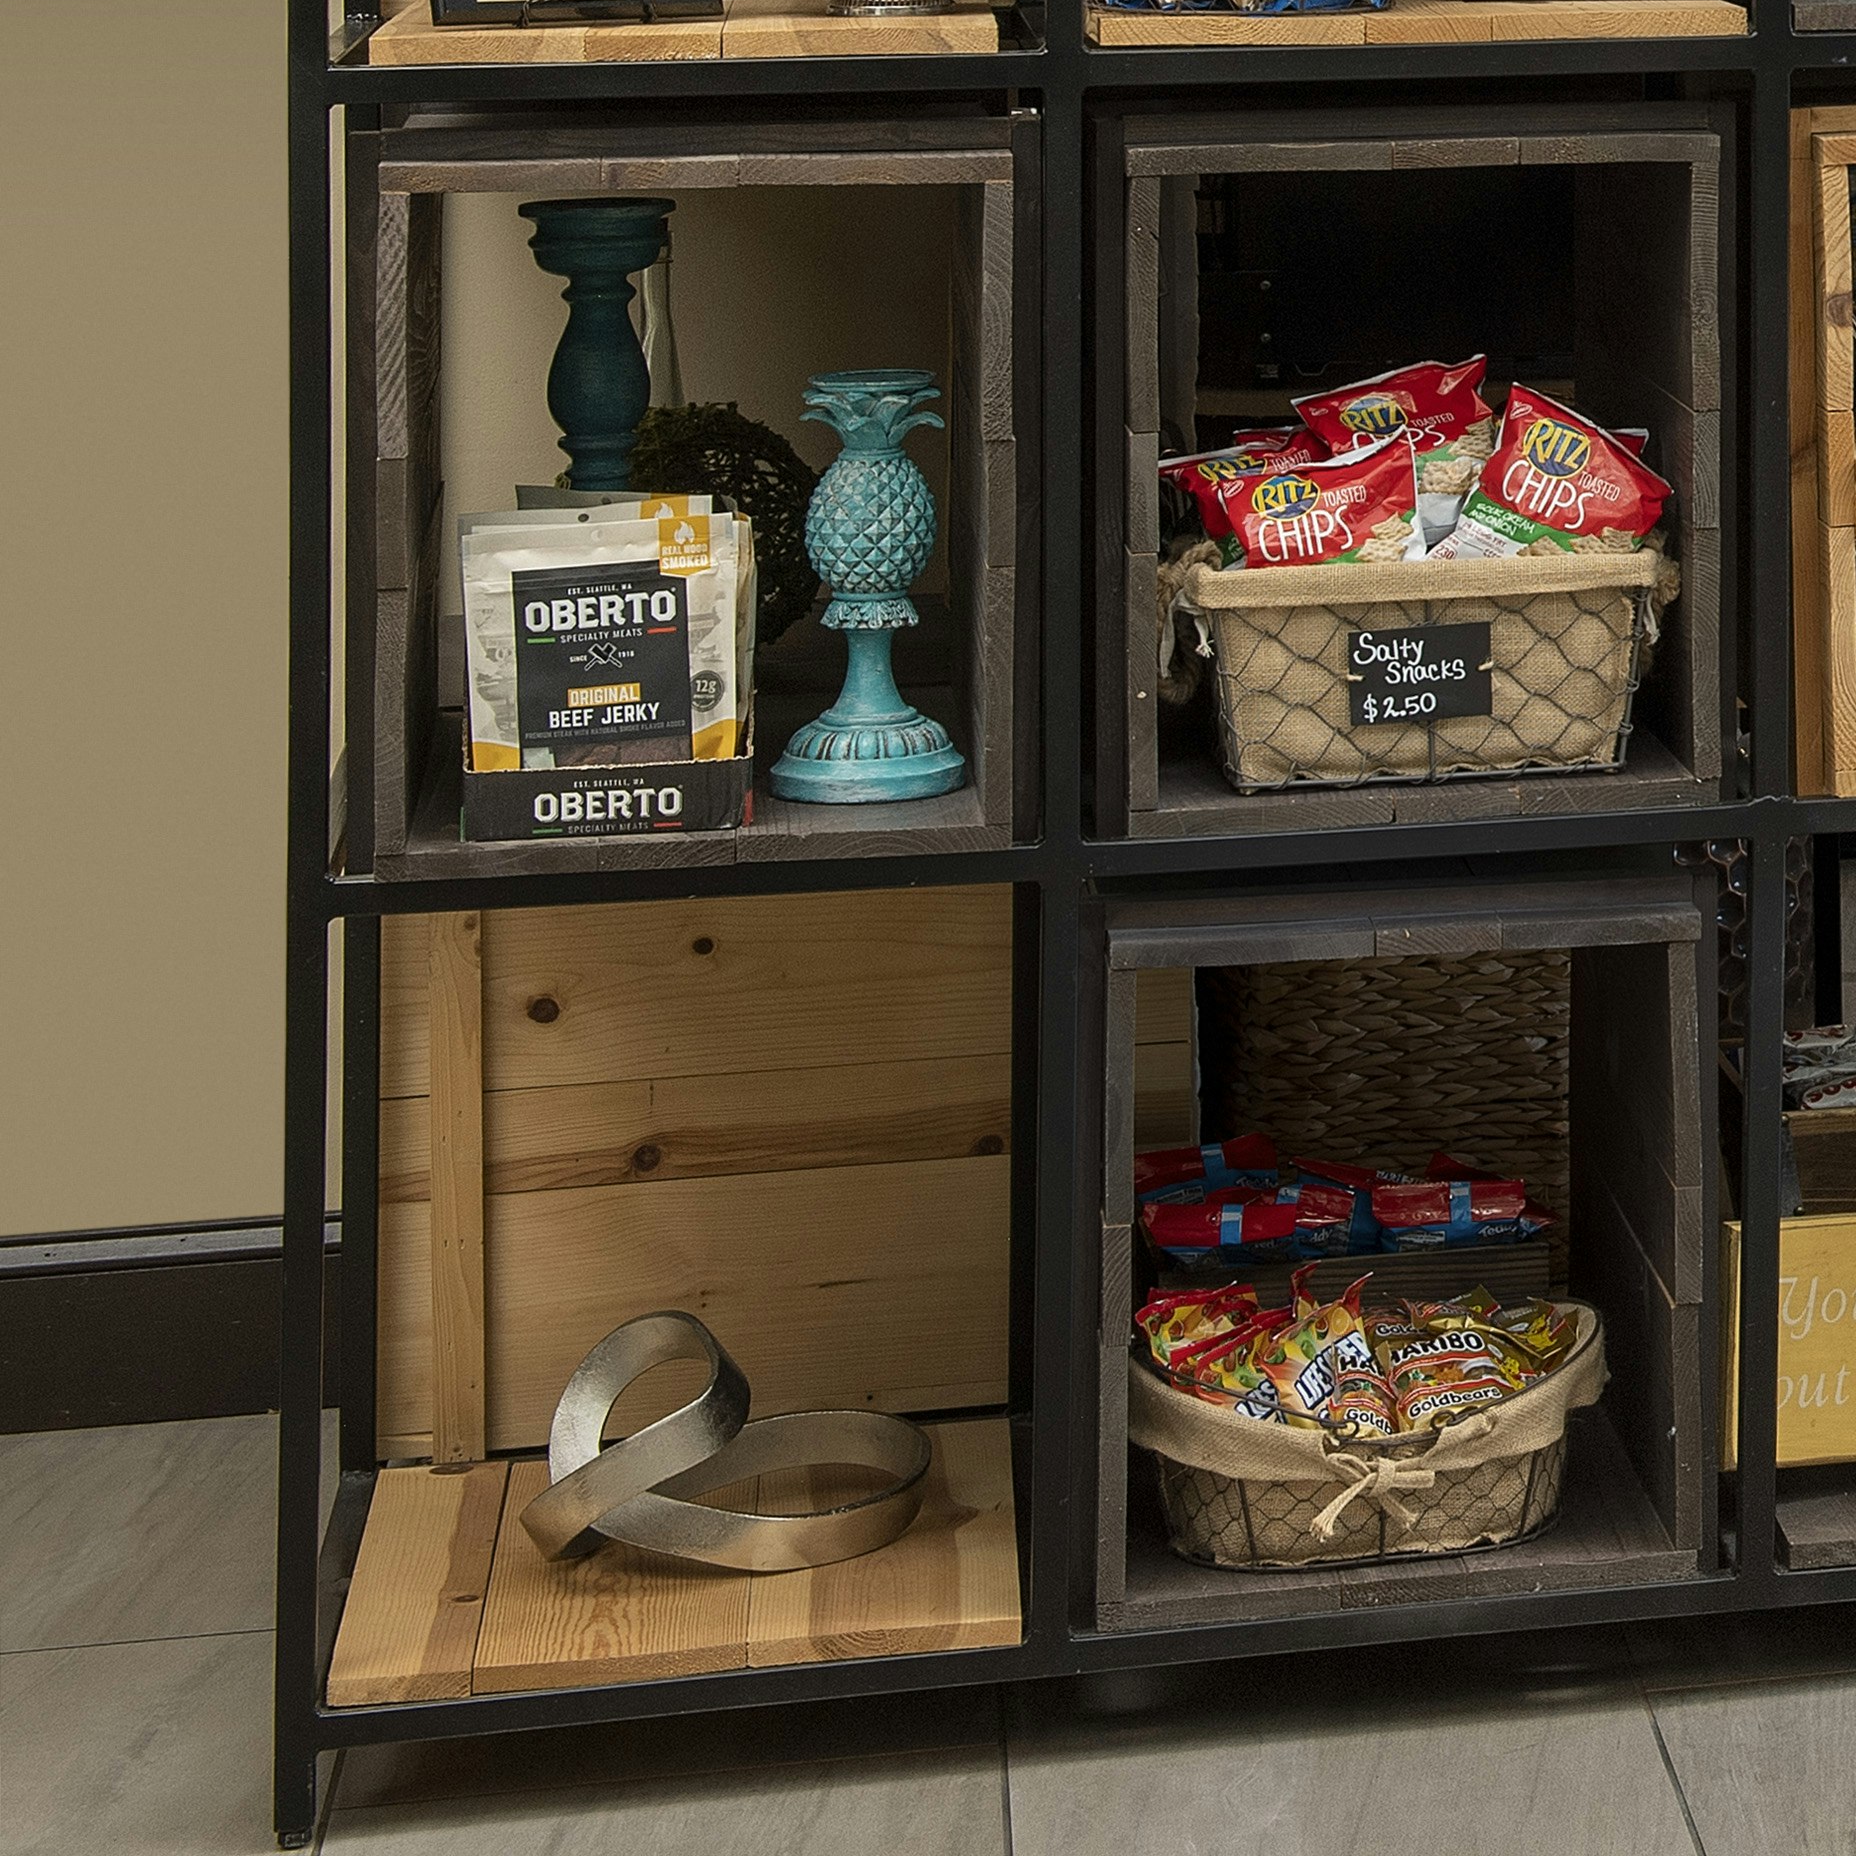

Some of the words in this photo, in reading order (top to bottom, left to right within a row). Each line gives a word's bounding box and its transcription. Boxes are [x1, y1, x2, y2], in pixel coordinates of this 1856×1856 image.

[1340, 396, 1407, 436] RITZ
[1410, 411, 1455, 428] TOASTED
[1523, 417, 1593, 480] RITZ
[1197, 453, 1267, 484] RITZ
[1252, 473, 1321, 521] RITZ
[1322, 484, 1368, 508] TOASTED
[1501, 458, 1596, 531] CHIPS
[1578, 469, 1622, 503] TOASTED
[1257, 501, 1355, 563] CHIPS
[1484, 514, 1518, 537] ONION
[1502, 511, 1537, 534] CREAM
[661, 543, 684, 556] REAL
[661, 553, 709, 570] SMOKED
[524, 589, 677, 633] OBERTO
[560, 630, 611, 644] SPECIALTY
[612, 627, 643, 639] MEATS
[1353, 632, 1425, 667] Salty
[1384, 657, 1467, 686] Snacks
[569, 688, 640, 708] ORIGINAL
[695, 679, 717, 696] 12g
[549, 708, 594, 729] BEEF
[601, 701, 661, 724] JERKY
[1363, 692, 1438, 725] $2.50
[533, 786, 683, 824] OBERTO
[567, 823, 617, 834] SPECIALTY
[1408, 1386, 1503, 1420] Goldbears
